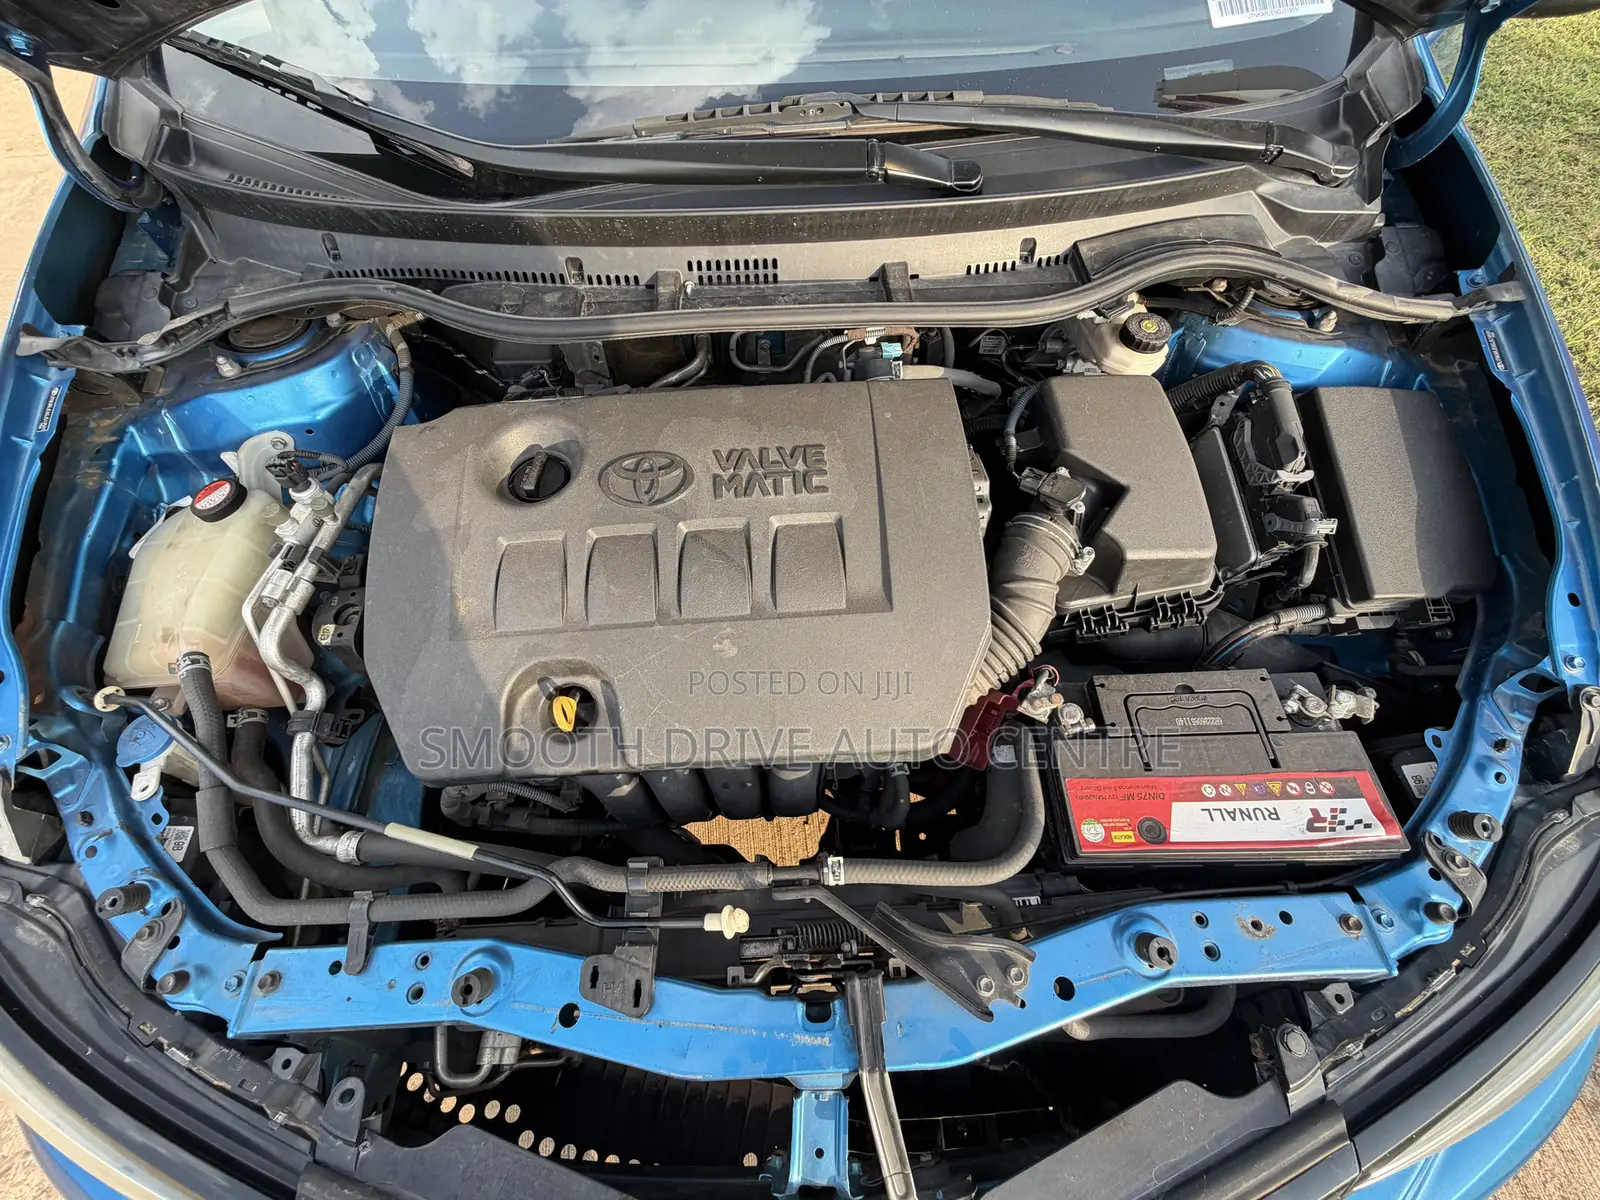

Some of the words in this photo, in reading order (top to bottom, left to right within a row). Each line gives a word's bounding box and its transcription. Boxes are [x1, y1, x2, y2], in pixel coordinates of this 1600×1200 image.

[712, 443, 827, 472] VALVE
[712, 468, 829, 500] MATIC
[1121, 792, 1135, 801] MF
[1136, 792, 1165, 801] DIN75
[1200, 807, 1281, 822] RUNALL
